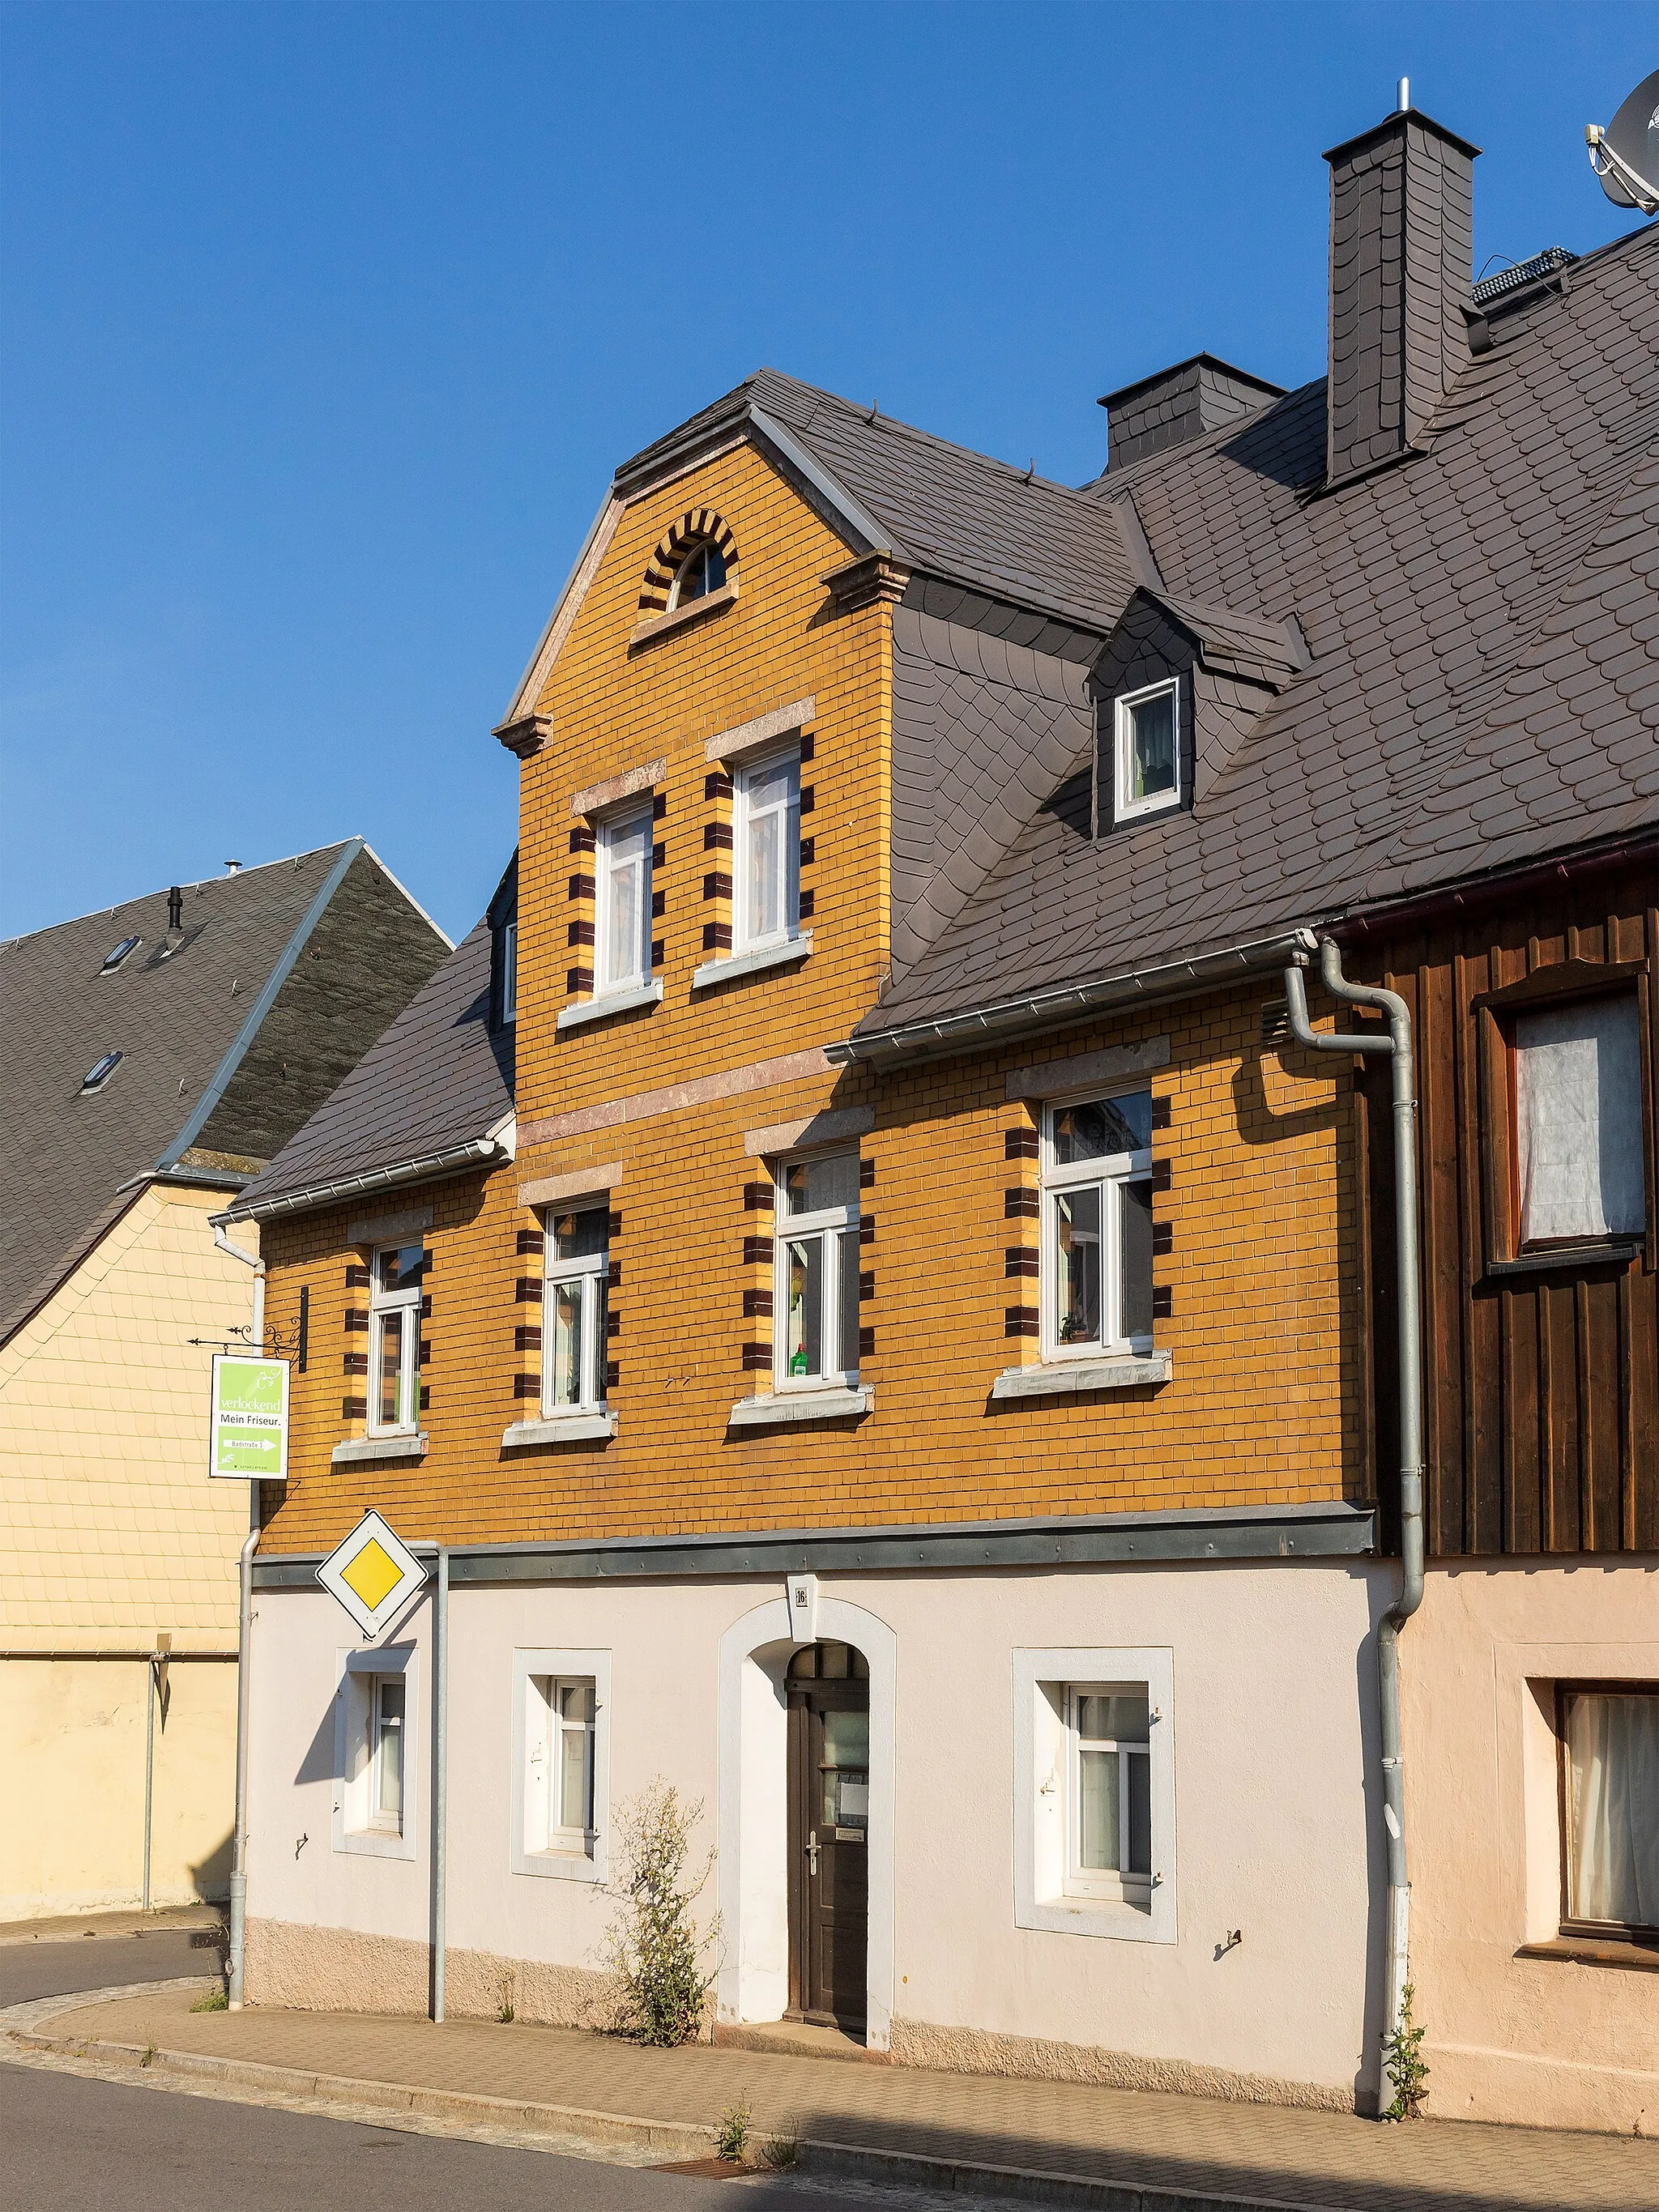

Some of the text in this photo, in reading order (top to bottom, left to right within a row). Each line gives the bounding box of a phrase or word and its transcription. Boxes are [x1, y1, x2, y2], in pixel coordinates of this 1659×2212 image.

[221, 1396, 280, 1411] verlockend
[220, 1414, 281, 1426] Mein Friseur.
[797, 1590, 804, 1603] 16
